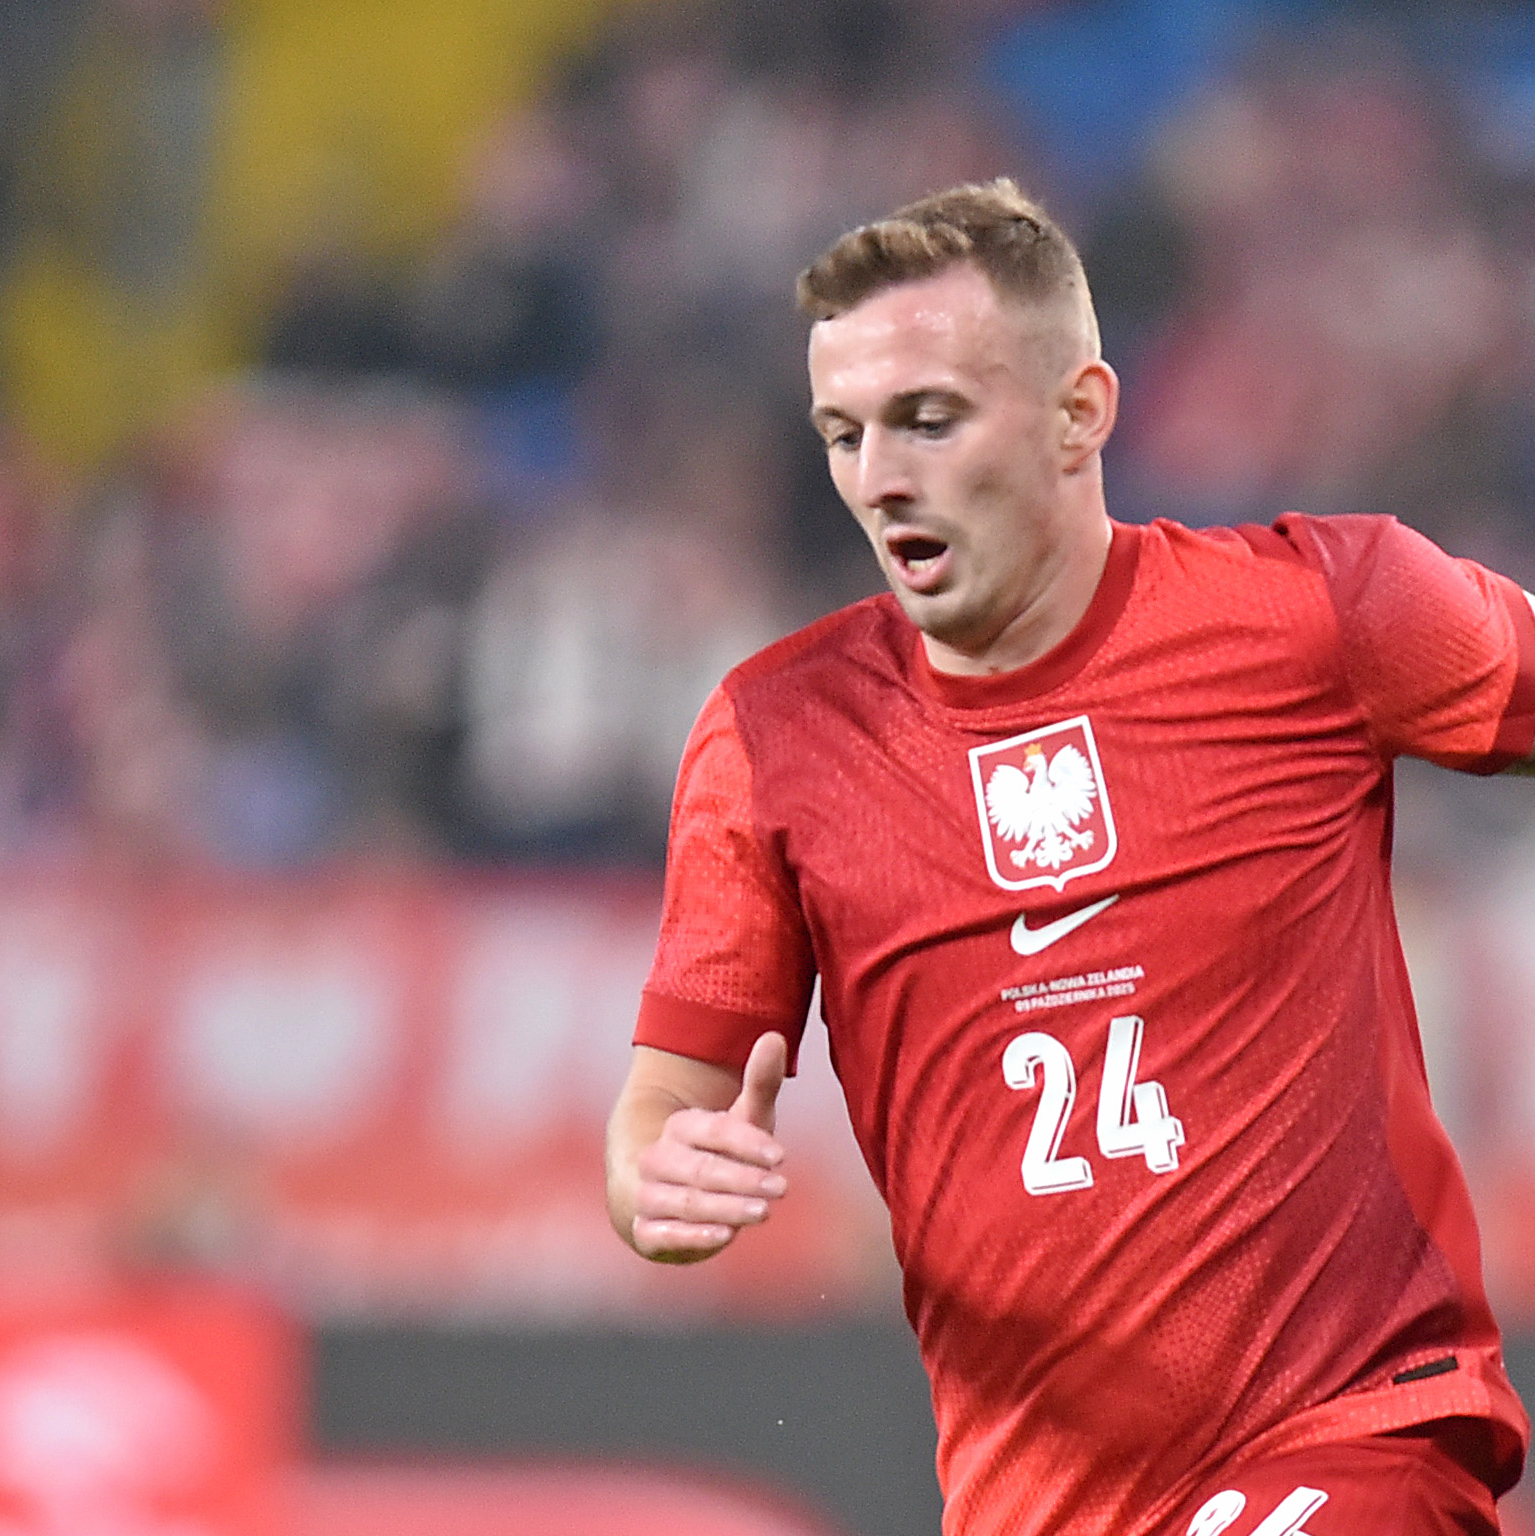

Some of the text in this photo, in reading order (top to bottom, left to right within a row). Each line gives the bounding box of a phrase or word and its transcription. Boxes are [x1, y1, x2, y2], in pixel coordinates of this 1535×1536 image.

[1087, 965, 1145, 986] ZELANDIA
[1107, 981, 1136, 998] 2025
[1002, 1015, 1185, 1196] 24
